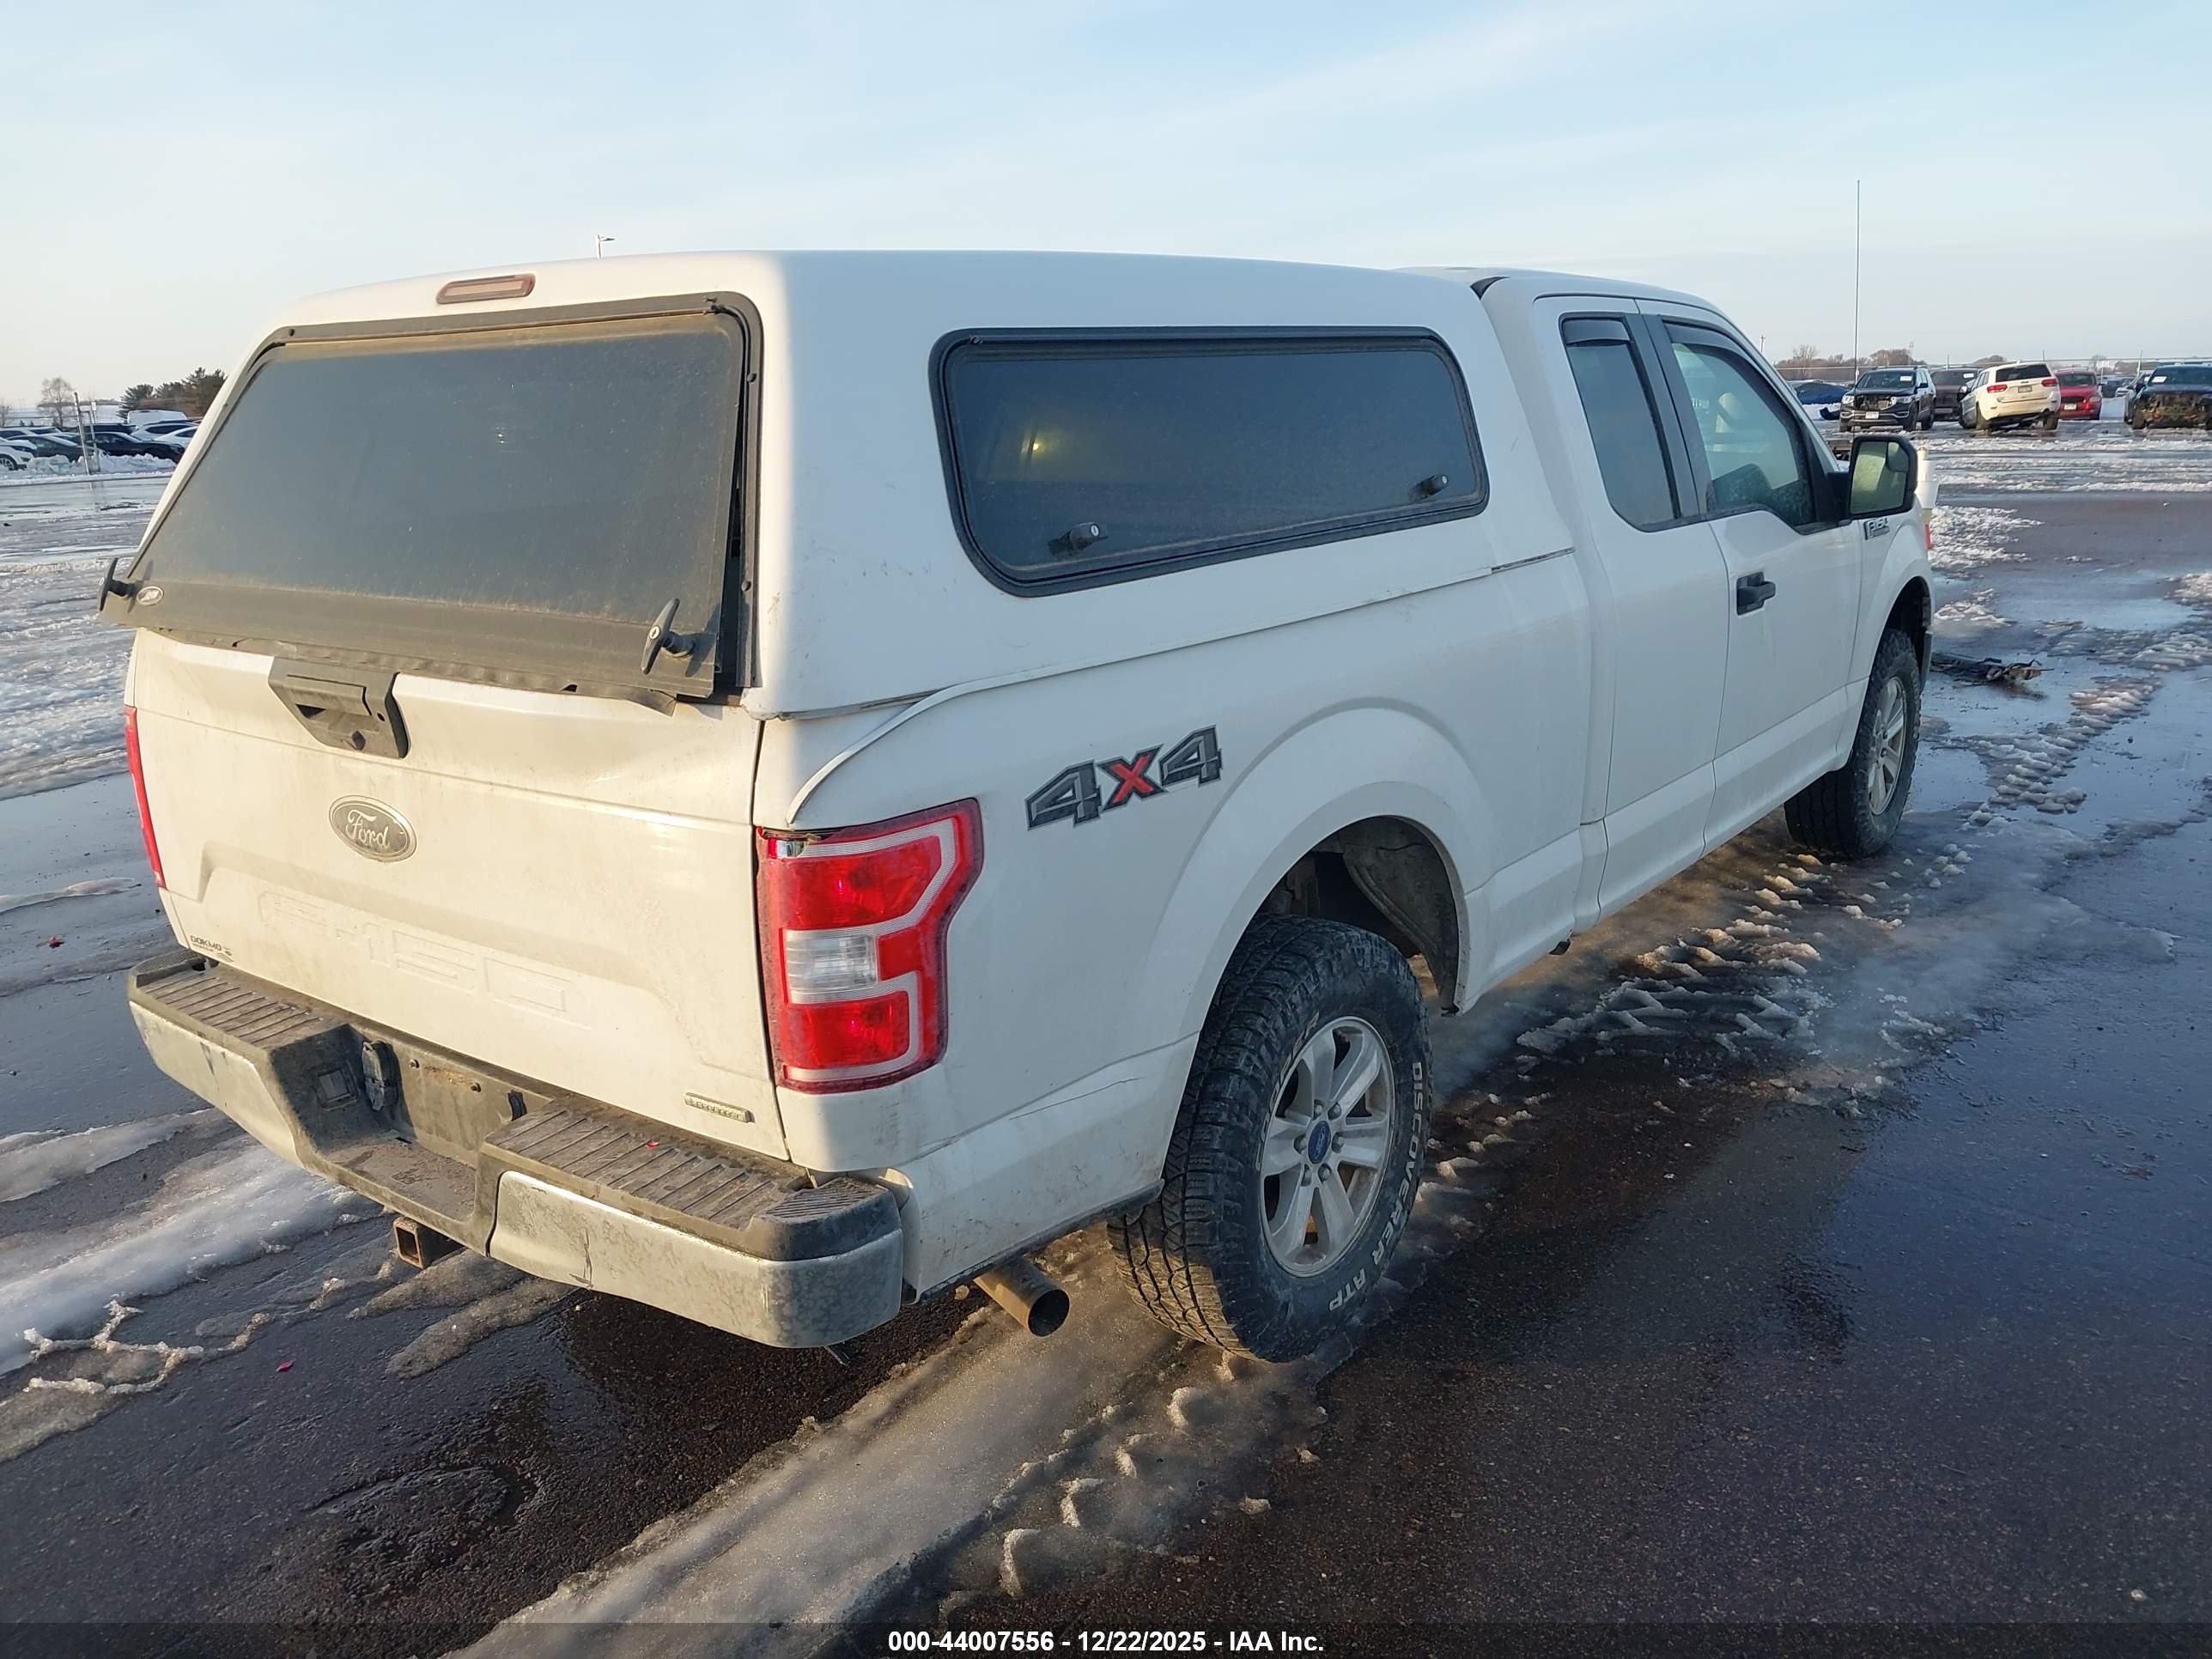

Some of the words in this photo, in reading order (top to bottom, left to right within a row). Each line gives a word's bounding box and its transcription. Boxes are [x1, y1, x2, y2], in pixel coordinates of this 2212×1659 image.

[345, 809, 390, 848] Ford
[258, 890, 592, 1030] F-150
[1371, 1061, 1424, 1266] DISCOVERER
[1328, 1267, 1366, 1311] ATP
